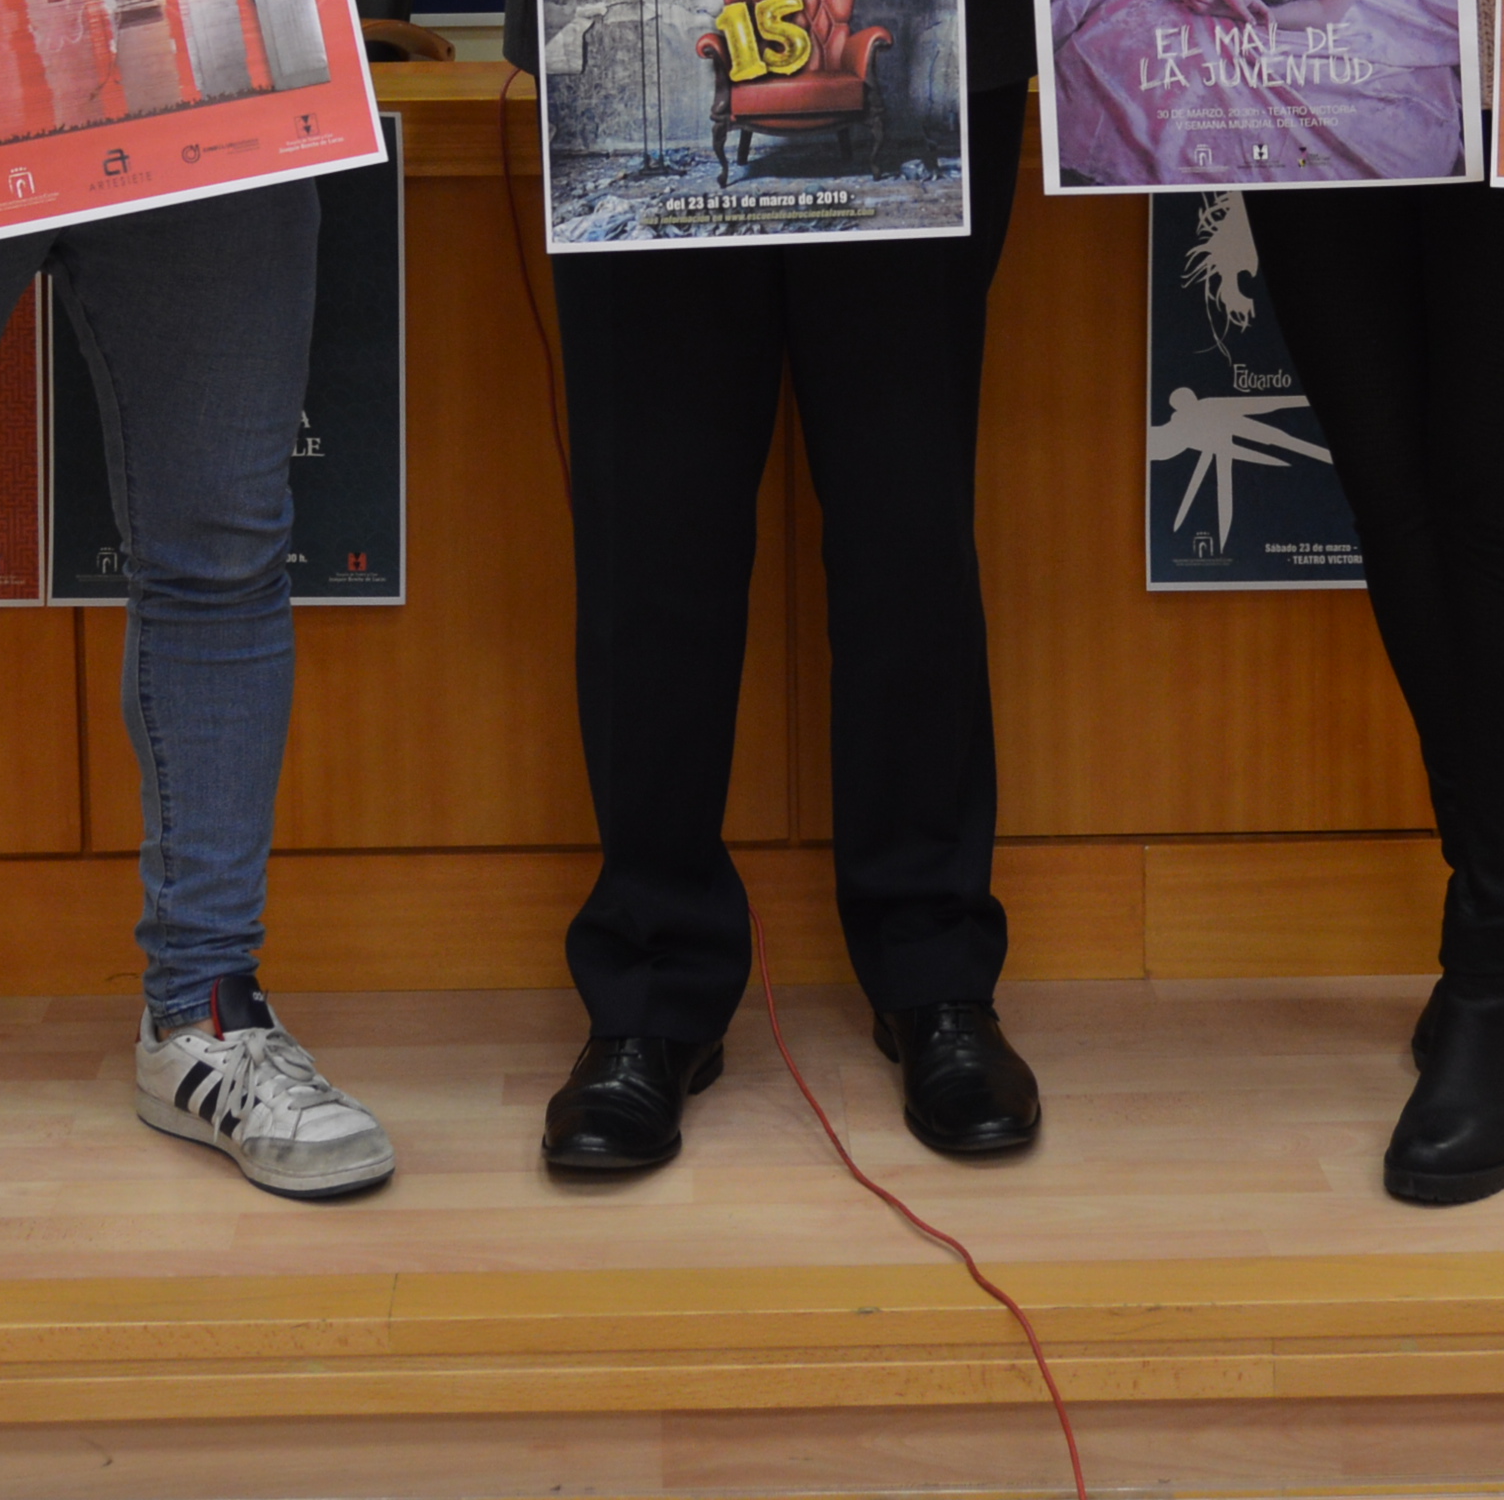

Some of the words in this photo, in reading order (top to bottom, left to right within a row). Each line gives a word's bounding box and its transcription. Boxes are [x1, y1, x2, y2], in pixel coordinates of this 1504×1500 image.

[1154, 23, 1203, 60] EL
[1214, 22, 1291, 57] MAL
[1306, 22, 1352, 54] DE
[1139, 57, 1191, 92] LA
[1200, 56, 1375, 90] JUVENTUD
[1156, 109, 1170, 120] 30
[1171, 109, 1186, 119] DE
[1267, 105, 1308, 117] TEATRO
[1308, 105, 1357, 116] VICTORIA
[1176, 120, 1183, 131] V
[1184, 119, 1227, 131] SEMANA
[1228, 118, 1274, 130] MUNDIAL
[1276, 118, 1296, 129] DEL
[1297, 116, 1339, 128] TEATRO
[89, 171, 153, 192] ARTESIETE
[666, 197, 686, 211] del
[688, 196, 705, 210] 23
[707, 196, 720, 209] al
[722, 195, 738, 209] 31
[741, 194, 756, 207] de
[759, 194, 796, 207] marzo
[798, 192, 813, 205] de
[816, 190, 848, 205] 2019
[1233, 363, 1292, 393] Eduardo
[1265, 542, 1297, 553] Sábado
[1298, 543, 1310, 553] 23
[1312, 542, 1324, 552] de
[1325, 543, 1352, 552] marzo
[1292, 555, 1325, 565] TEATRO
